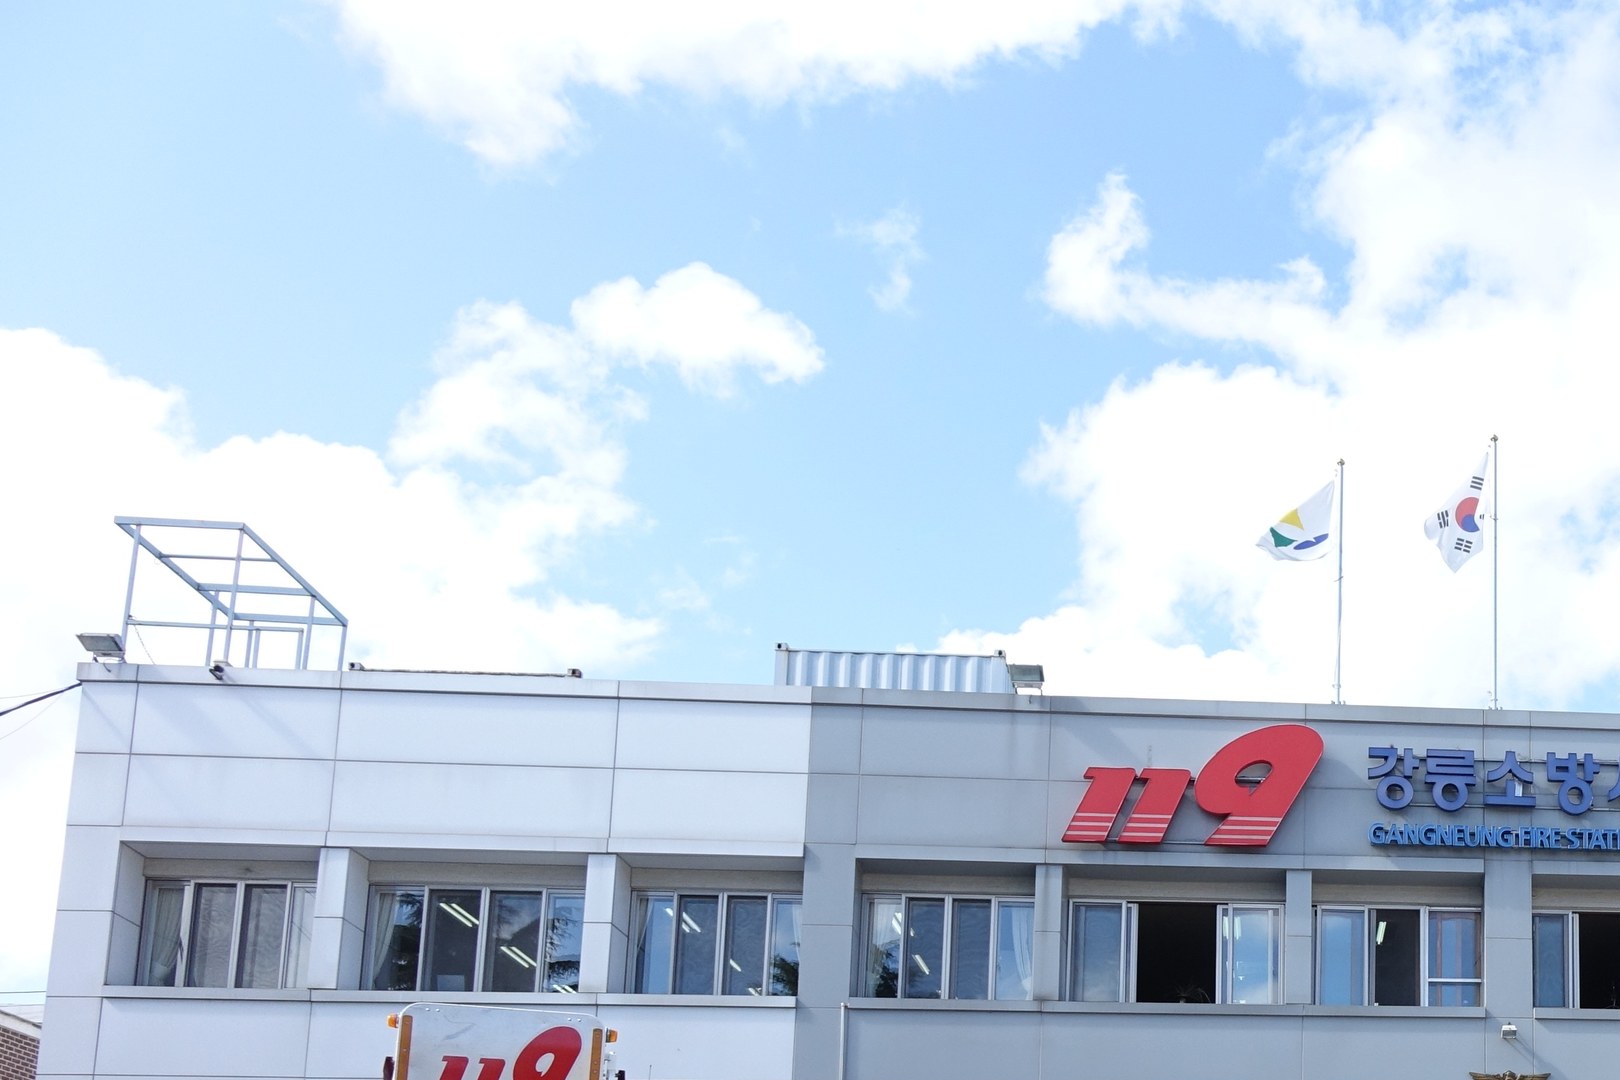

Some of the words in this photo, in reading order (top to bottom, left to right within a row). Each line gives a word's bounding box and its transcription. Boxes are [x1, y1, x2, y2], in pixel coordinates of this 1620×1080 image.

[1061, 724, 1325, 847] 119
[1368, 822, 1514, 847] GANGNEUNG
[1519, 826, 1560, 848] FIRE
